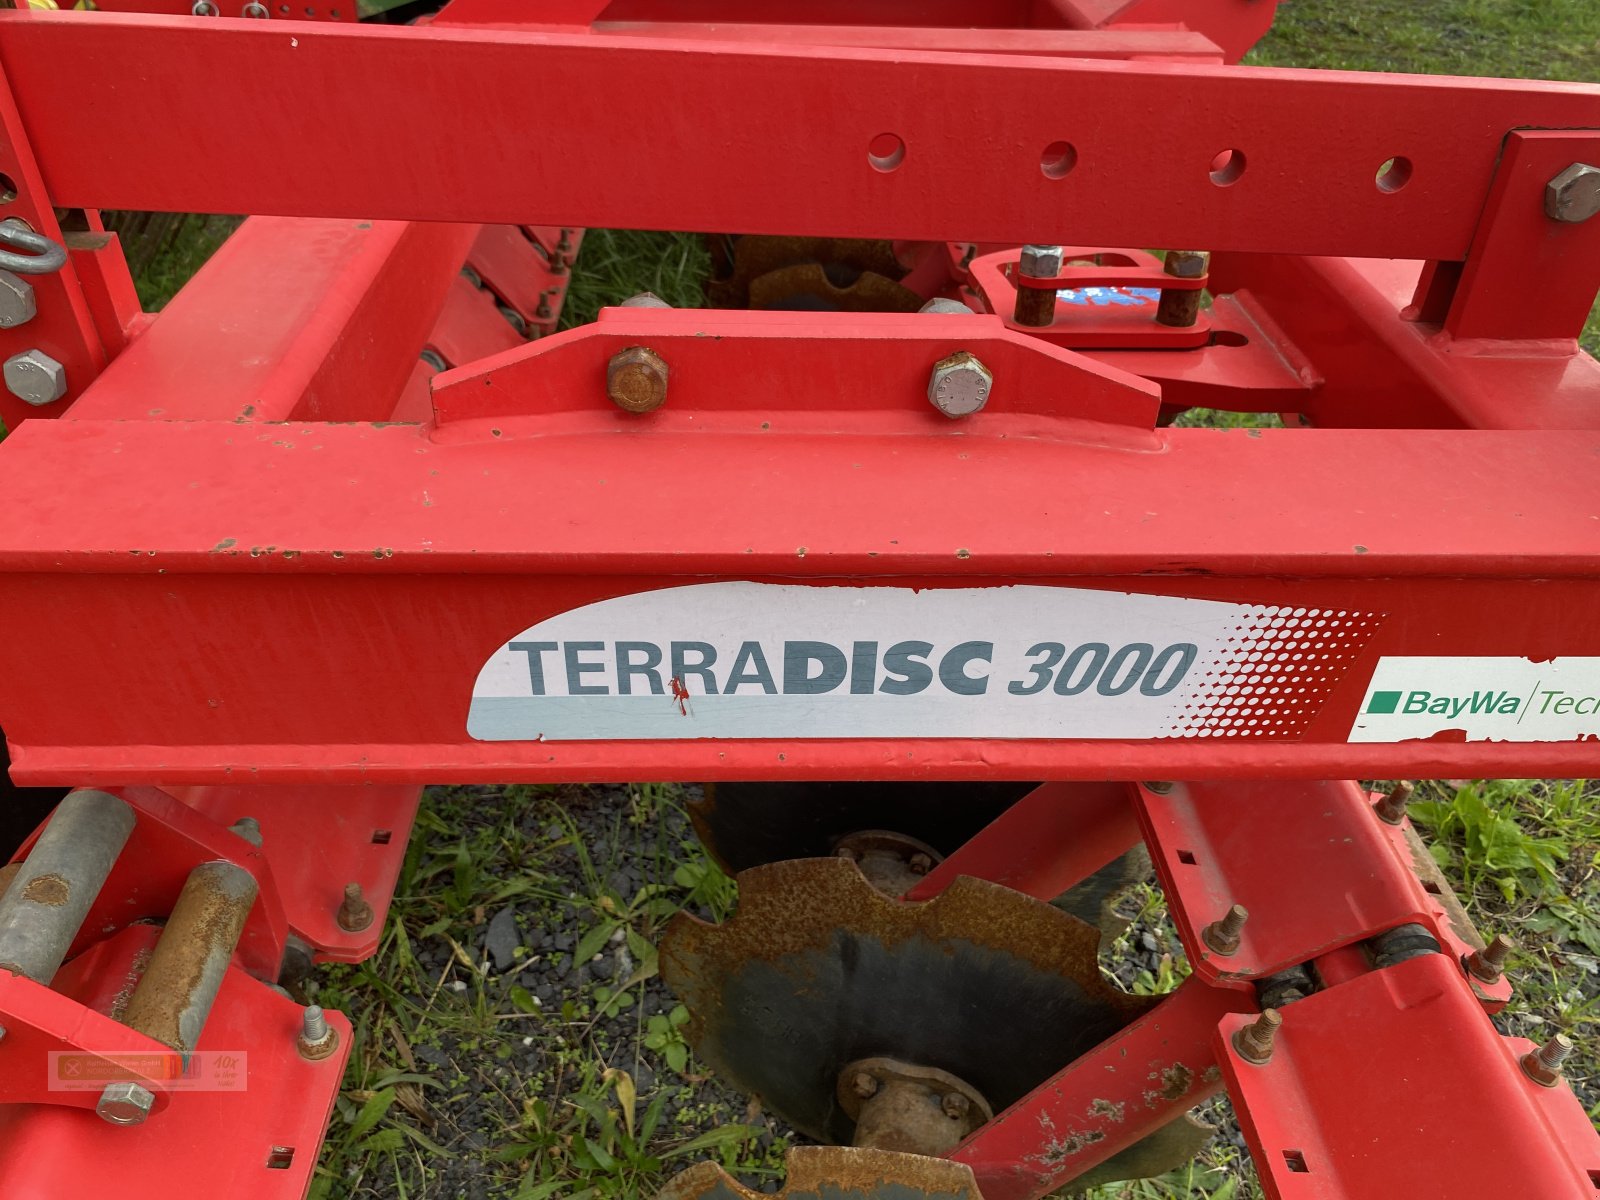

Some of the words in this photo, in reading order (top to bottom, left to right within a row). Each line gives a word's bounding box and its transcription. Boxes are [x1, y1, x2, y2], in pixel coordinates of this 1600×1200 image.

[508, 640, 994, 696] TERRADISC
[1007, 641, 1199, 697] 3000
[1401, 690, 1522, 719] BayWa
